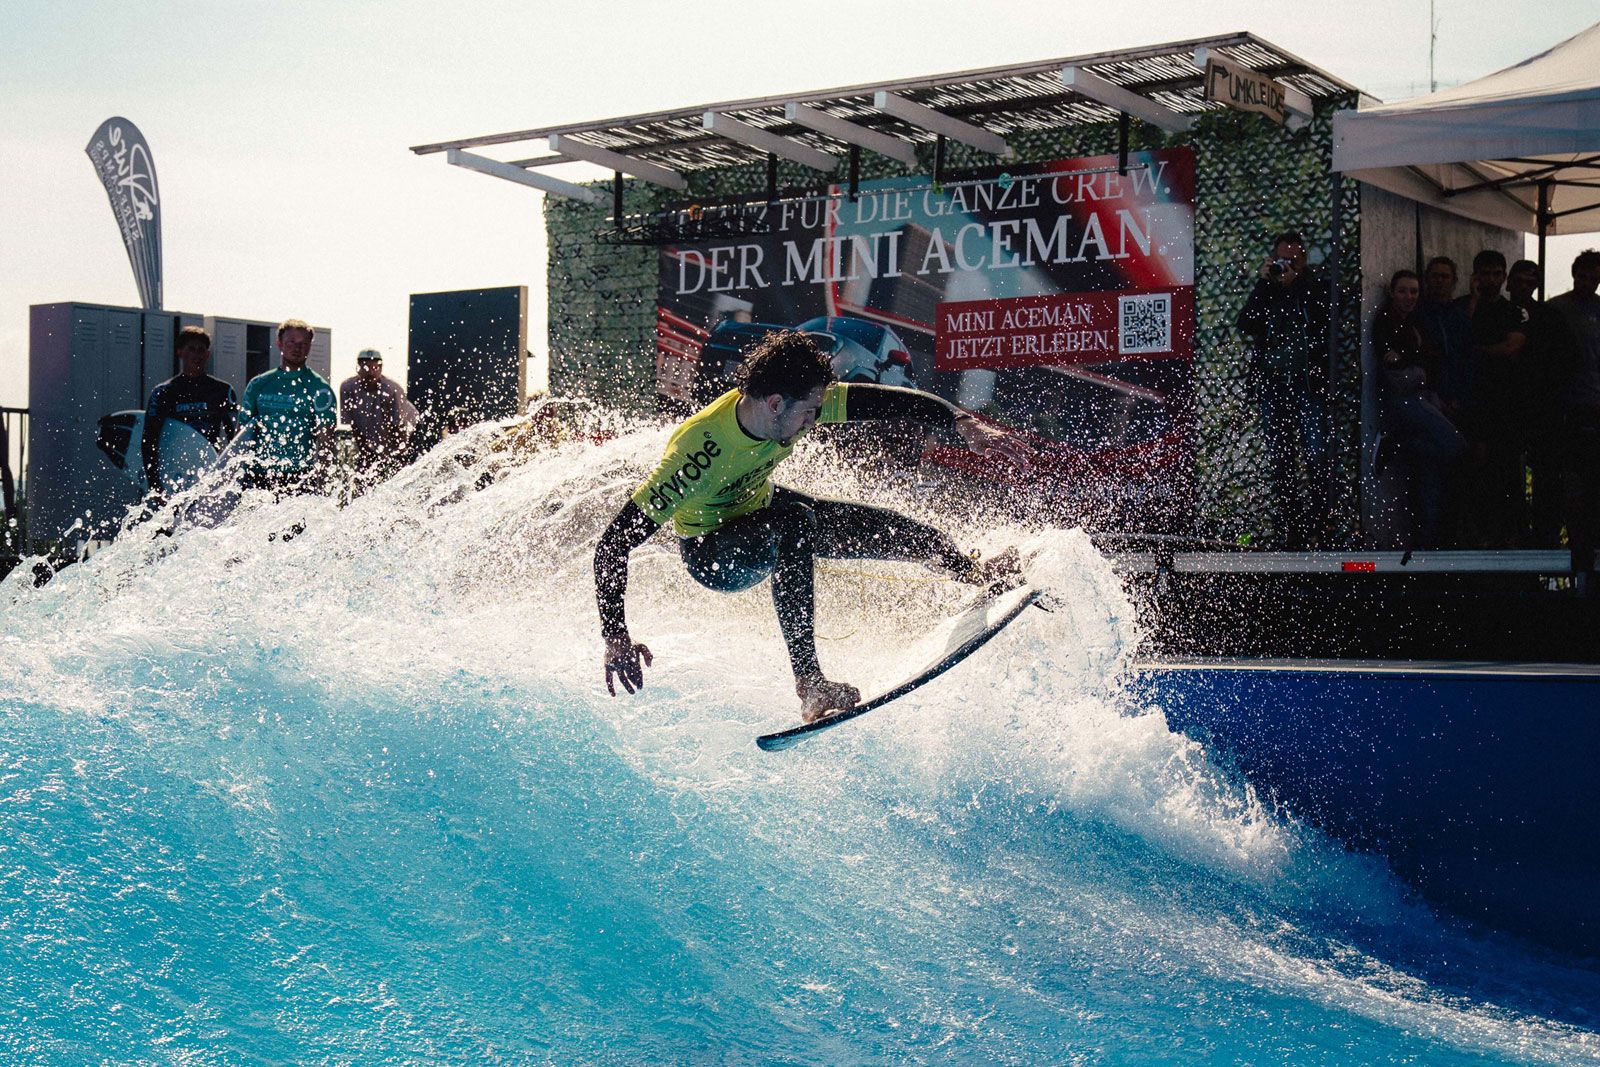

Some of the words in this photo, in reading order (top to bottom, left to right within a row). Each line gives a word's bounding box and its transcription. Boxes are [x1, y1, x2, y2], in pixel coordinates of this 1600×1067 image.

[1229, 72, 1284, 116] UMKLEIDE
[778, 190, 844, 231] FÜR
[854, 188, 914, 224] DIE
[923, 177, 1042, 217] GANZE
[1051, 161, 1171, 204] CREW.
[675, 243, 768, 295] DER
[781, 231, 903, 286] MINI
[946, 310, 995, 333] MINI
[1001, 304, 1092, 330] ACEMAN
[945, 335, 1005, 360] JETZT
[1011, 329, 1114, 355] ERLEBEN.
